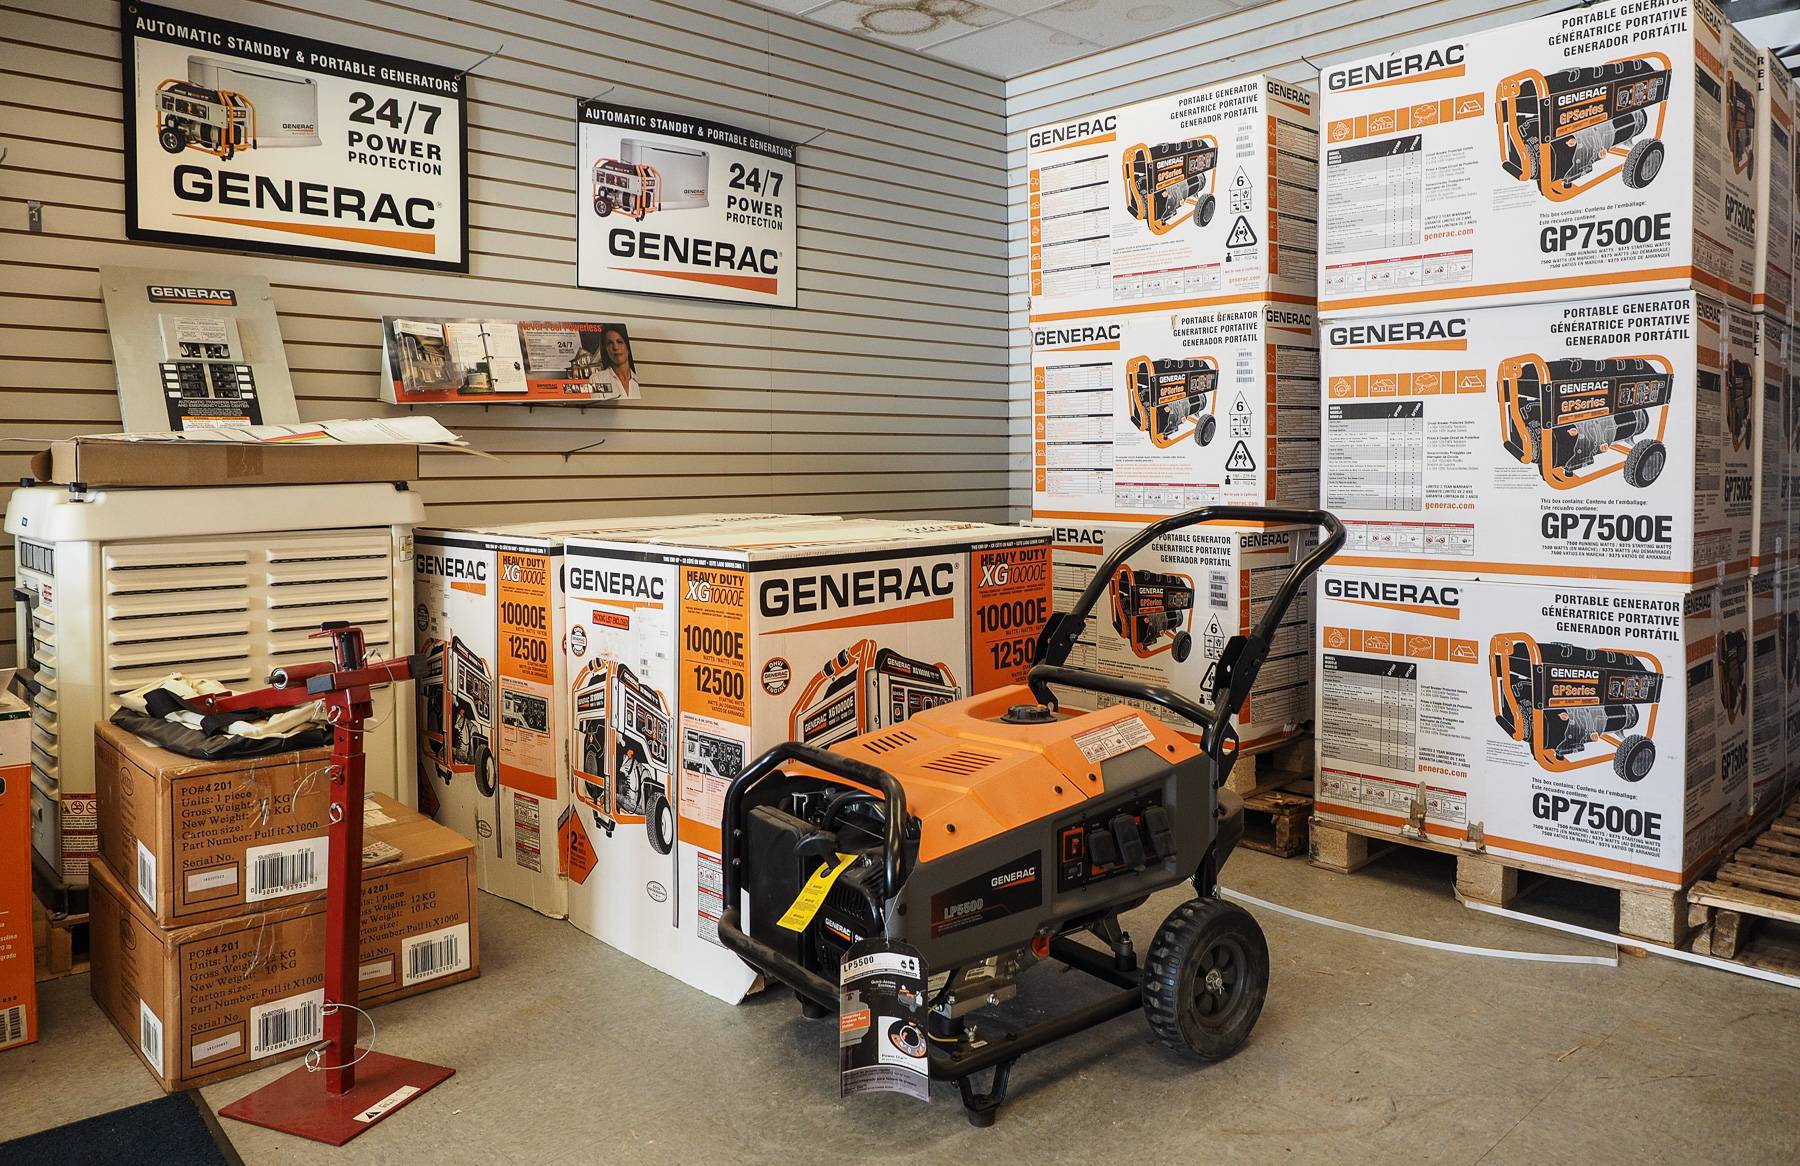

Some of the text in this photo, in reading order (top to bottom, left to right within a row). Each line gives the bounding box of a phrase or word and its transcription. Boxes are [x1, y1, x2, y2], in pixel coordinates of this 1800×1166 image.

[1549, 21, 1622, 46] GÉNÉRATRICE
[1625, 7, 1688, 29] PORTATIVE
[1562, 8, 1616, 29] PORTABLE
[1564, 22, 1688, 57] GENERADOR PORTÁTIL
[136, 16, 458, 93] AUTOMATIC STANDBY & PORTABLE GENERATORS
[1328, 44, 1465, 91] GENERAC
[1178, 82, 1258, 107] PORTABLE GENERATOR
[1219, 93, 1258, 110] PORTATIVE
[1266, 81, 1310, 106] GENERAC
[1558, 85, 1607, 107] GENERAC
[348, 91, 442, 135] 24/7
[1180, 113, 1222, 129] GENERADOR
[1559, 104, 1605, 126] GPSeries
[585, 108, 793, 159] AUTOMATIC STANDBY & PORTABLE GENERATORS
[1029, 115, 1117, 149] GENERAC
[348, 130, 442, 161] POWER
[348, 151, 442, 176] PROTECTION
[728, 162, 783, 198] 24/7
[1236, 175, 1244, 187] 6
[173, 164, 436, 230] GENERAC
[727, 195, 783, 218] POWER
[726, 213, 783, 231] PROTECTION
[1424, 227, 1474, 242] generac.com
[1540, 212, 1671, 253] GP7500E
[608, 228, 779, 275] GENERAC
[150, 286, 231, 300] GENERAC
[1181, 310, 1258, 326] PORTABLE GENERATOR
[1266, 309, 1311, 326] GENERAC
[1564, 305, 1619, 318] PORTABLE
[1623, 299, 1690, 314] GENERATOR
[1220, 322, 1258, 334] PORTATIVE
[1330, 318, 1466, 346] GENERAC
[1550, 314, 1690, 334] GÉNÉRATRICE PORTATIVE
[1034, 324, 1121, 347] GENERAC
[1182, 336, 1222, 348] GENERADOR
[1566, 328, 1690, 347] GENERADOR PORTÁTIL
[1158, 373, 1186, 384] GENERAC
[1560, 381, 1609, 394] GENERAC
[1236, 401, 1244, 413] 6
[1561, 397, 1606, 413] GPSeries
[1425, 502, 1475, 511] generac.com
[1541, 512, 1673, 543] GP7500E
[1158, 532, 1231, 545] PORTABLE GENERATOR
[1239, 533, 1289, 548] GENERAC
[980, 548, 1047, 566] HEAVY DUTY
[1160, 554, 1232, 567] GENERADOR PORTÁTIL
[1196, 545, 1231, 556] PORTATIVE
[415, 553, 487, 581] GENERAC
[502, 555, 546, 568] HEAVY DUTY
[570, 567, 664, 600] GENERAC
[687, 570, 745, 587] HEAVY DUTY
[759, 562, 955, 618] GENERAC
[1139, 587, 1164, 595] GENERAC
[1324, 578, 1459, 606] GENERAC
[1555, 593, 1609, 607] PORTABLE
[1613, 598, 1680, 612] GENERATOR
[501, 600, 546, 630] 10000E
[976, 597, 1047, 633] 10000E
[1541, 605, 1680, 627] GÉNÉRATRICE PORTATIVE
[1210, 623, 1218, 634] 6
[1556, 621, 1680, 641] GENERADOR PORTÁTIL
[508, 634, 547, 663] 12500
[683, 624, 744, 660] 10000E
[887, 657, 911, 670] GENERAC
[1550, 668, 1599, 679] GENERAC
[693, 665, 745, 700] 12500
[764, 670, 788, 679] GENERAC
[766, 683, 787, 694] ENGINE
[1552, 684, 1596, 697] GPSeries
[804, 713, 827, 732] GENERAC
[1418, 764, 1468, 778] generac.com
[182, 793, 252, 807] Units: piece
[182, 795, 291, 818] Gross KG
[182, 805, 291, 830] New Weight: KG
[1532, 792, 1662, 841] GP7500E
[182, 825, 244, 840] Carton size:
[182, 820, 319, 852] Part Number: X1000
[182, 852, 235, 868] Serial No.
[991, 867, 1035, 887] GENERAC
[374, 891, 436, 913] Weight: 12 KG
[382, 890, 405, 904] piece
[369, 901, 437, 924] Weight: 10 KG
[943, 898, 984, 920] LP5500
[368, 928, 406, 943] Number:
[433, 913, 459, 926] X1000
[379, 921, 399, 932] size:
[825, 917, 851, 937] GENERAC
[376, 946, 392, 955] No.
[189, 959, 221, 971] Units:
[189, 949, 296, 982] Gross KG
[843, 955, 874, 973] LP5500
[190, 960, 297, 993] New 10 KG
[190, 973, 323, 1015] Part Number: Pull it X1000
[190, 985, 251, 1004] Carton size:
[190, 1013, 242, 1032] Serial No.
